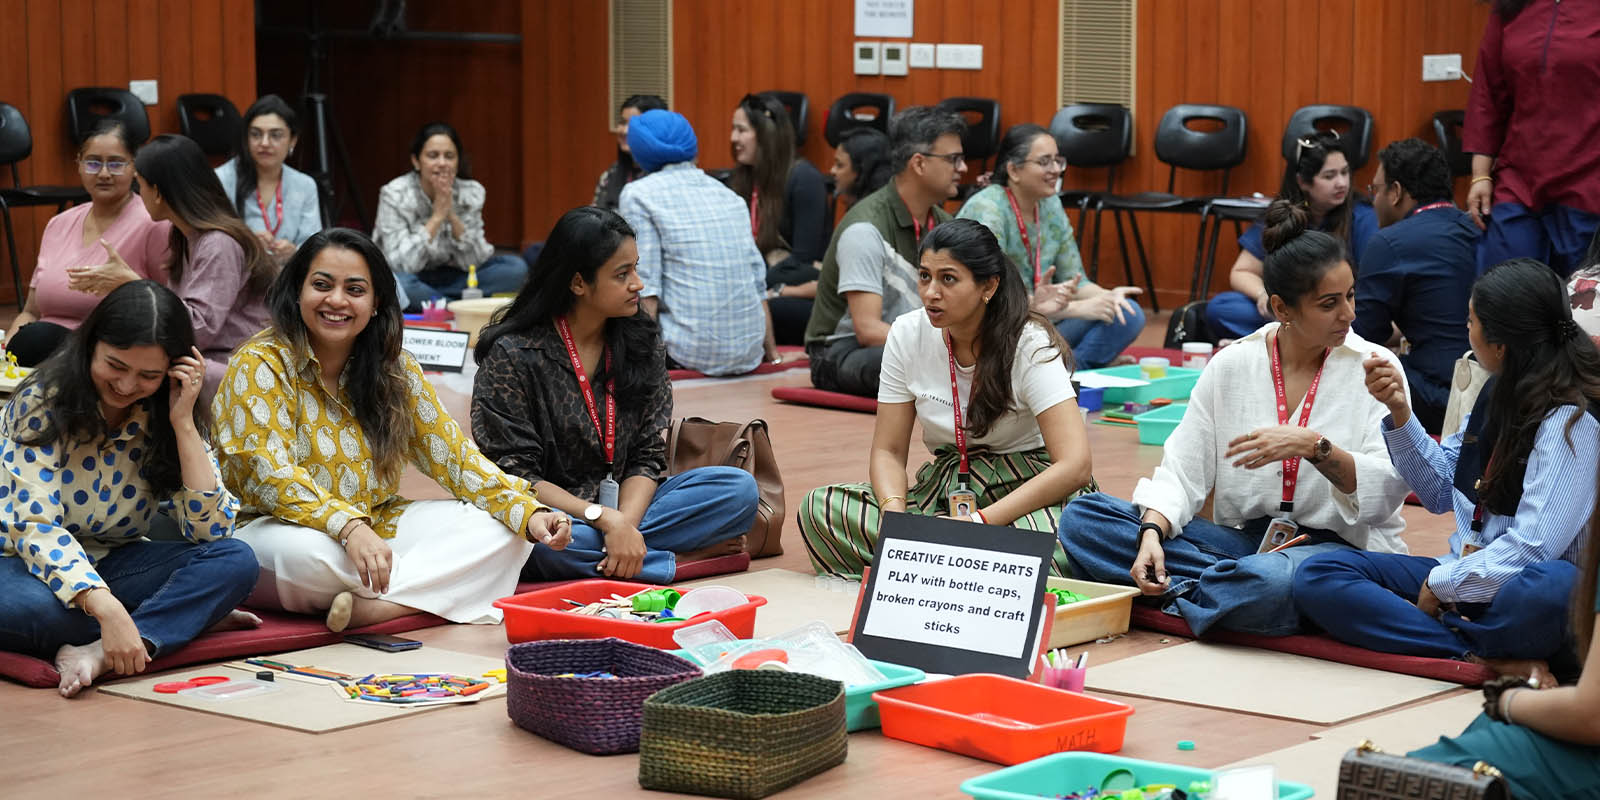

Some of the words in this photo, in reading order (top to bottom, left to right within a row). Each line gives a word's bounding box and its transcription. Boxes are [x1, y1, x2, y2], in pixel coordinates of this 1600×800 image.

[404, 337, 433, 345] LOWER
[435, 339, 466, 349] BLOOM
[887, 549, 945, 565] CREATIVE
[948, 556, 989, 571] LOOSE
[992, 562, 1033, 577] PARTS
[888, 570, 918, 583] PLAY
[921, 576, 945, 587] with
[949, 578, 984, 592] bottle
[988, 586, 1021, 600] caps,
[876, 591, 915, 605] broken
[918, 598, 964, 612] crayons
[967, 606, 991, 616] and
[994, 609, 1025, 621] craft
[924, 620, 960, 634] sticks
[1056, 728, 1097, 751] MATH
